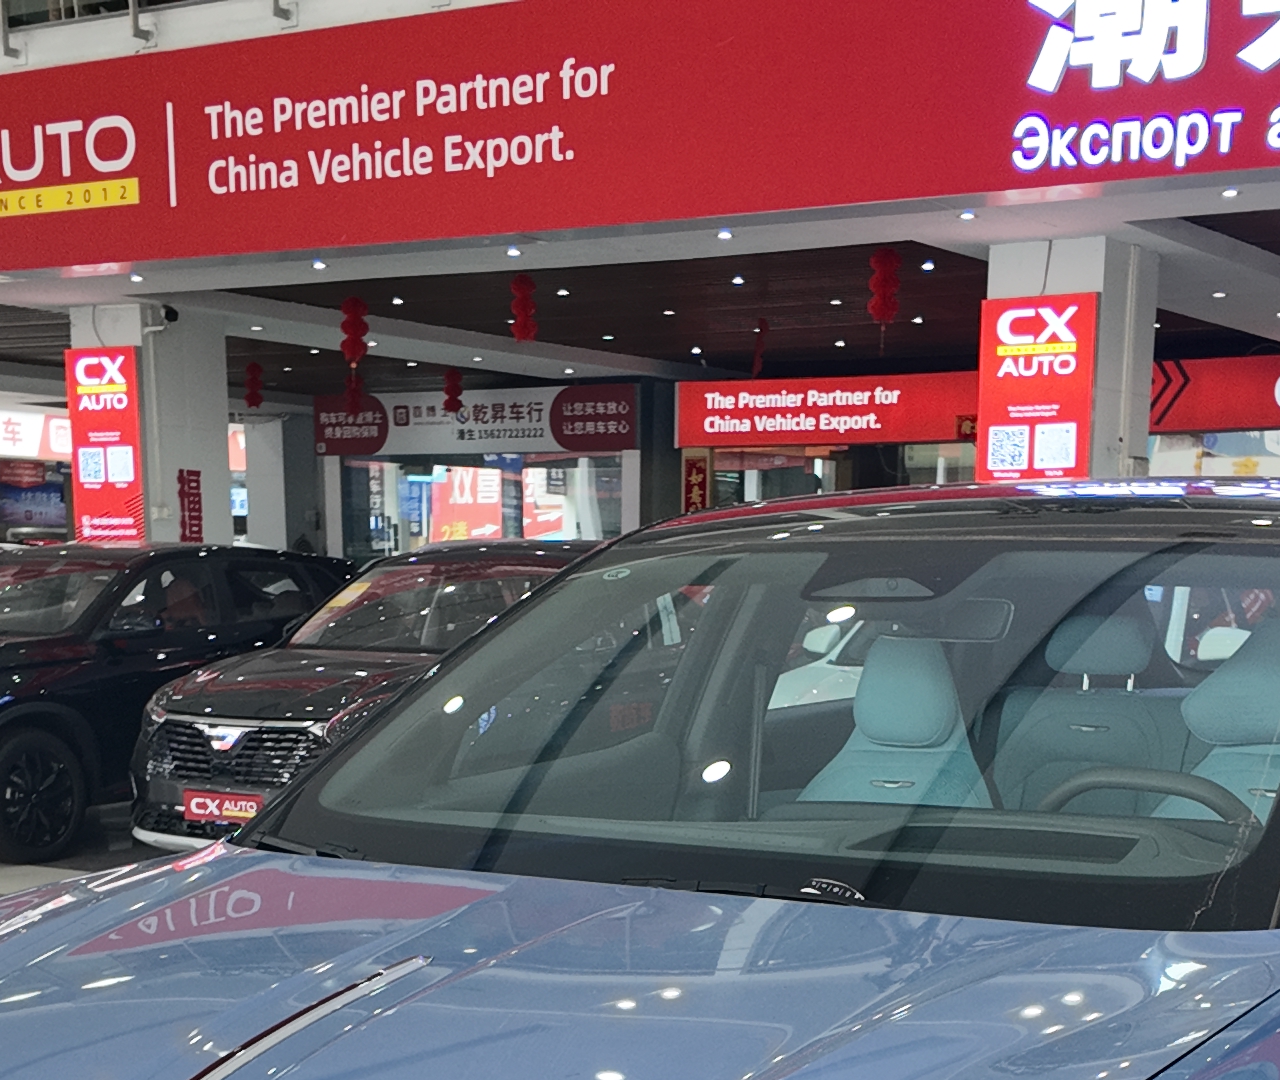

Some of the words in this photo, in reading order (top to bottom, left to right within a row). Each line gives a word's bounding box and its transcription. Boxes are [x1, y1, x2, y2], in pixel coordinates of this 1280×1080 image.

[205, 103, 264, 141] The
[273, 90, 405, 132] Premier
[415, 69, 549, 118] Partner
[557, 57, 616, 103] for
[1012, 107, 1243, 170] Экспорт
[207, 153, 300, 196] China
[307, 134, 434, 188] Vehicle
[444, 126, 576, 178] Export.
[64, 184, 131, 206] 2012
[996, 305, 1079, 346] CX
[75, 355, 126, 386] CX
[996, 353, 1077, 378] AUTO
[78, 393, 129, 411] AUTO
[562, 401, 630, 416] 让您买车放心
[704, 392, 736, 409] The
[738, 390, 804, 409] Premier
[806, 388, 871, 407] Partner
[874, 386, 901, 405] for
[472, 402, 544, 425] 乾昇车行
[703, 415, 751, 433] China
[753, 413, 816, 432] Vehicle
[819, 412, 882, 434] Export.
[562, 420, 630, 436] 让您用车安心
[190, 797, 221, 816] CX
[221, 799, 258, 815] AUTO
